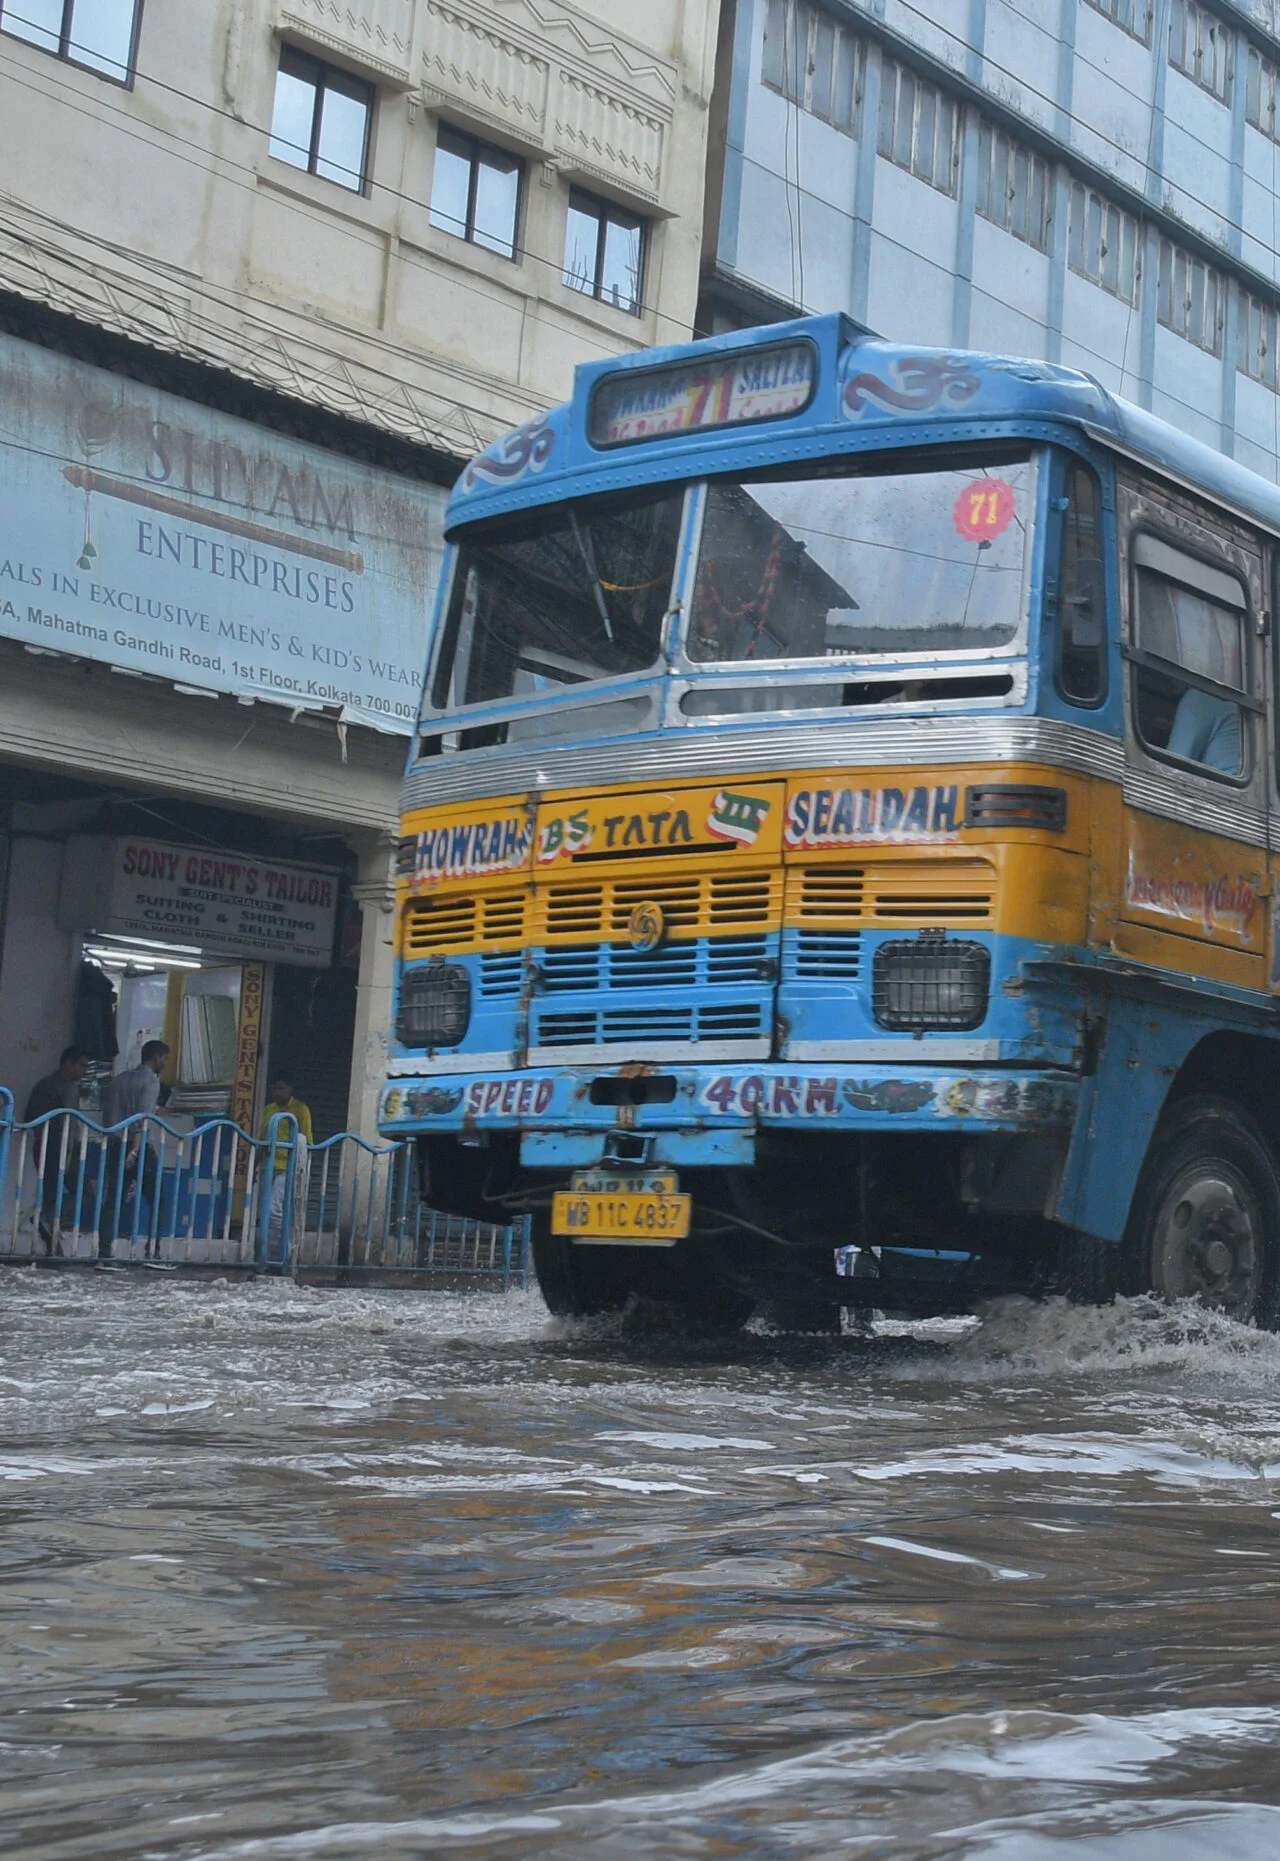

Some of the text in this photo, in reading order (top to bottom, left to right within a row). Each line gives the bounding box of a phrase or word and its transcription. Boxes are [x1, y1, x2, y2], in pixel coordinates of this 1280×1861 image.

[686, 370, 735, 425] 71
[969, 492, 999, 525] 71
[136, 518, 355, 614] ENTERPRISES
[51, 572, 80, 597] IN
[89, 582, 211, 634] EXCLUSIVE
[217, 618, 281, 652] MEN'S
[287, 635, 305, 659] &
[311, 643, 363, 673] KID'S
[368, 658, 423, 689] WEAR
[0, 600, 420, 721] A, Mahatma Gandhi Road, 1st Floor, Kolkata 700 007
[603, 809, 695, 849] TATA
[789, 784, 961, 840] SEALDAH
[415, 818, 519, 875] HOWRAH
[123, 846, 333, 909] SONY GENT'S TAILOR
[135, 893, 316, 932] SUITING & SHIRTING
[143, 908, 296, 942] CLOTH SELLER
[243, 969, 261, 1019] SONY
[468, 1078, 554, 1115] SPEED
[596, 1202, 629, 1228] 11C
[634, 1203, 682, 1230] 4837
